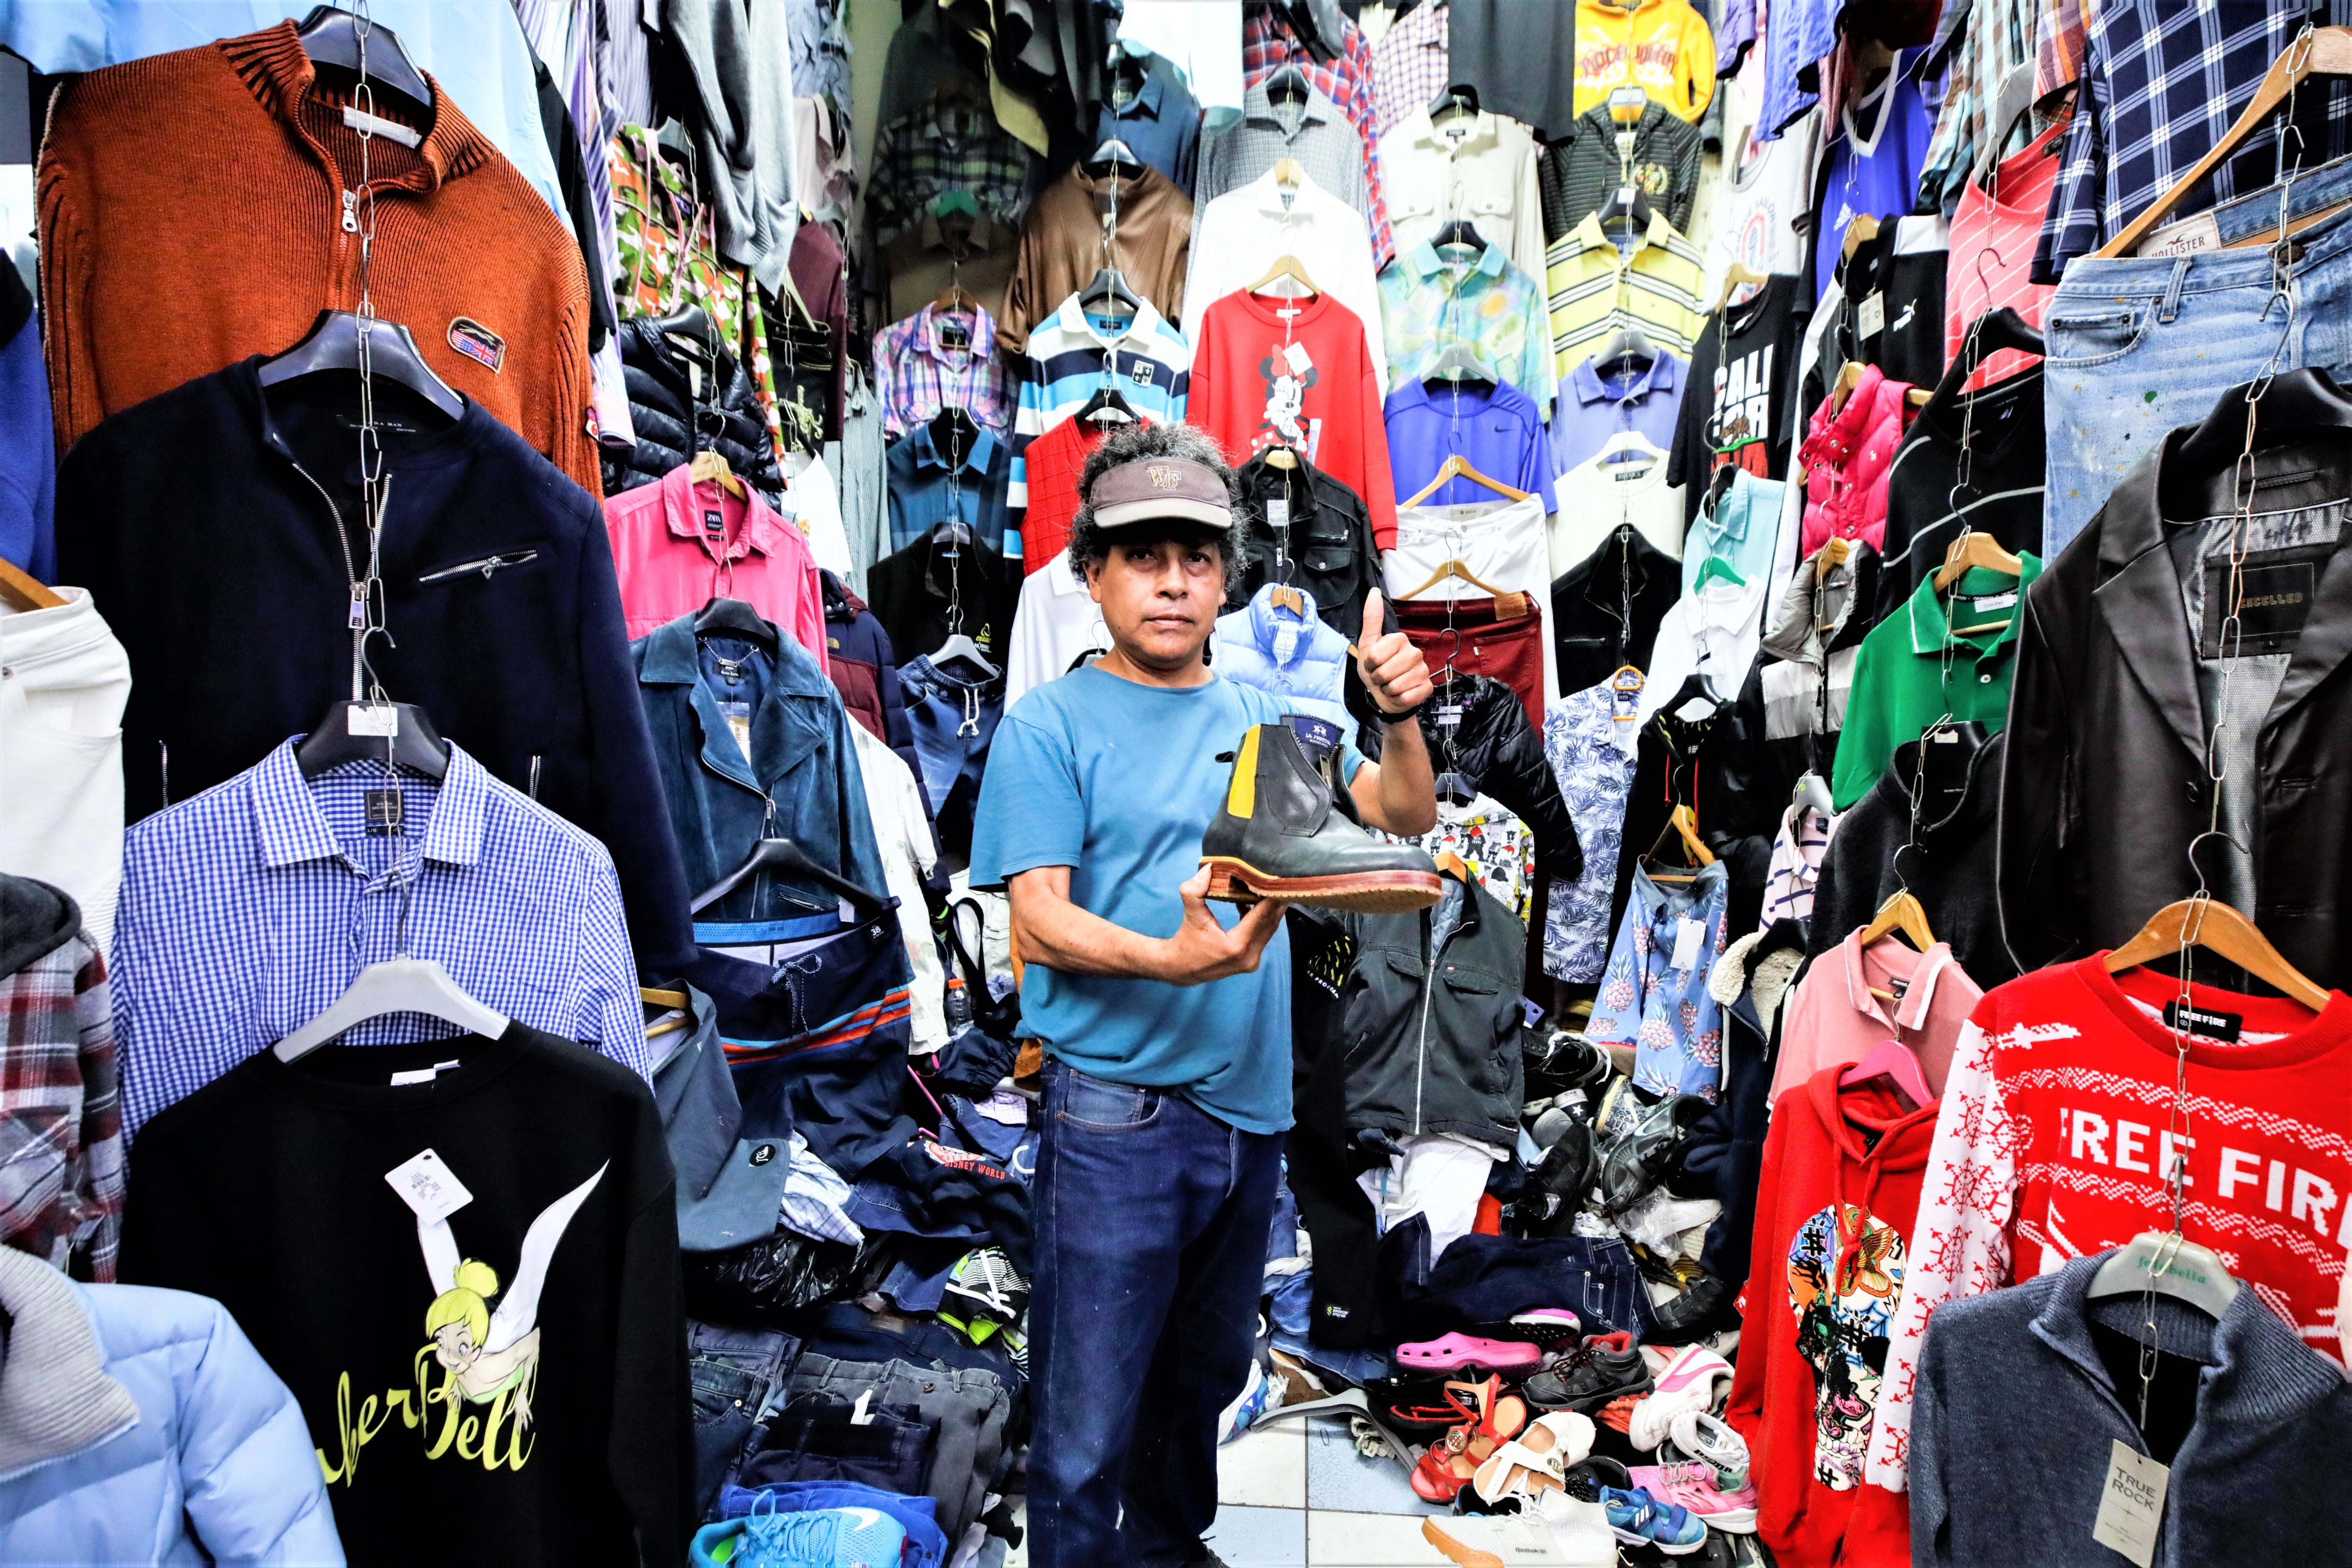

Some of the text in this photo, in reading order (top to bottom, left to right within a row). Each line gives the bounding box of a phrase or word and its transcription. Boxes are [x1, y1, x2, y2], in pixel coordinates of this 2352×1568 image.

[2152, 236, 2205, 257] OLLISTER
[2240, 592, 2303, 609] EXCELLED
[1313, 736, 1331, 745] MARTINA
[871, 926, 882, 936] 38
[945, 1160, 1006, 1180] DISNEY WORLD
[2217, 1146, 2352, 1249] FIR
[2116, 1466, 2156, 1498] TRUE
[2112, 1479, 2154, 1511] ROCK
